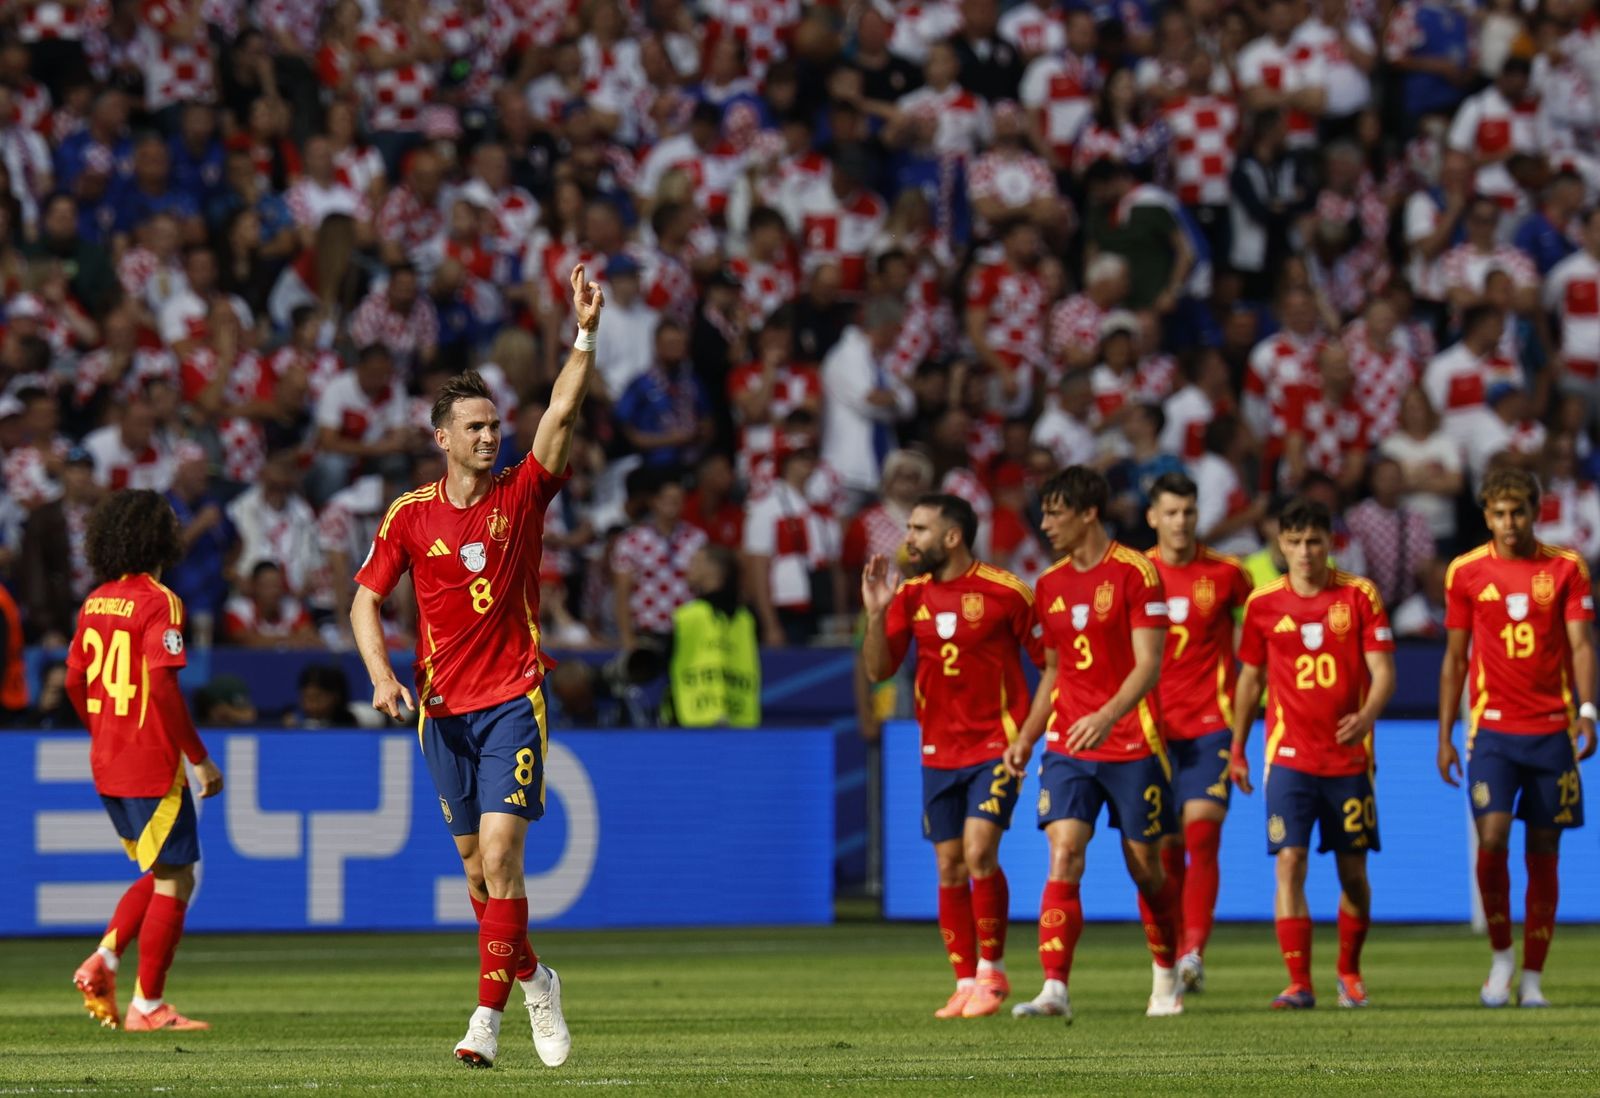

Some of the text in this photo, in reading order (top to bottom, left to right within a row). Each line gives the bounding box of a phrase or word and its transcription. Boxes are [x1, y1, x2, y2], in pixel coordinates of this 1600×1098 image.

[469, 577, 494, 614] 8
[1073, 634, 1093, 670] 3
[1169, 625, 1189, 659] 7
[1500, 622, 1535, 659] 19
[82, 627, 137, 716] 24
[941, 643, 960, 676] 2
[1295, 653, 1337, 689] 20
[514, 747, 535, 785] 8
[990, 763, 1010, 797] 2
[1143, 784, 1163, 819] 3
[1556, 770, 1580, 806] 19
[1343, 795, 1377, 833] 20
